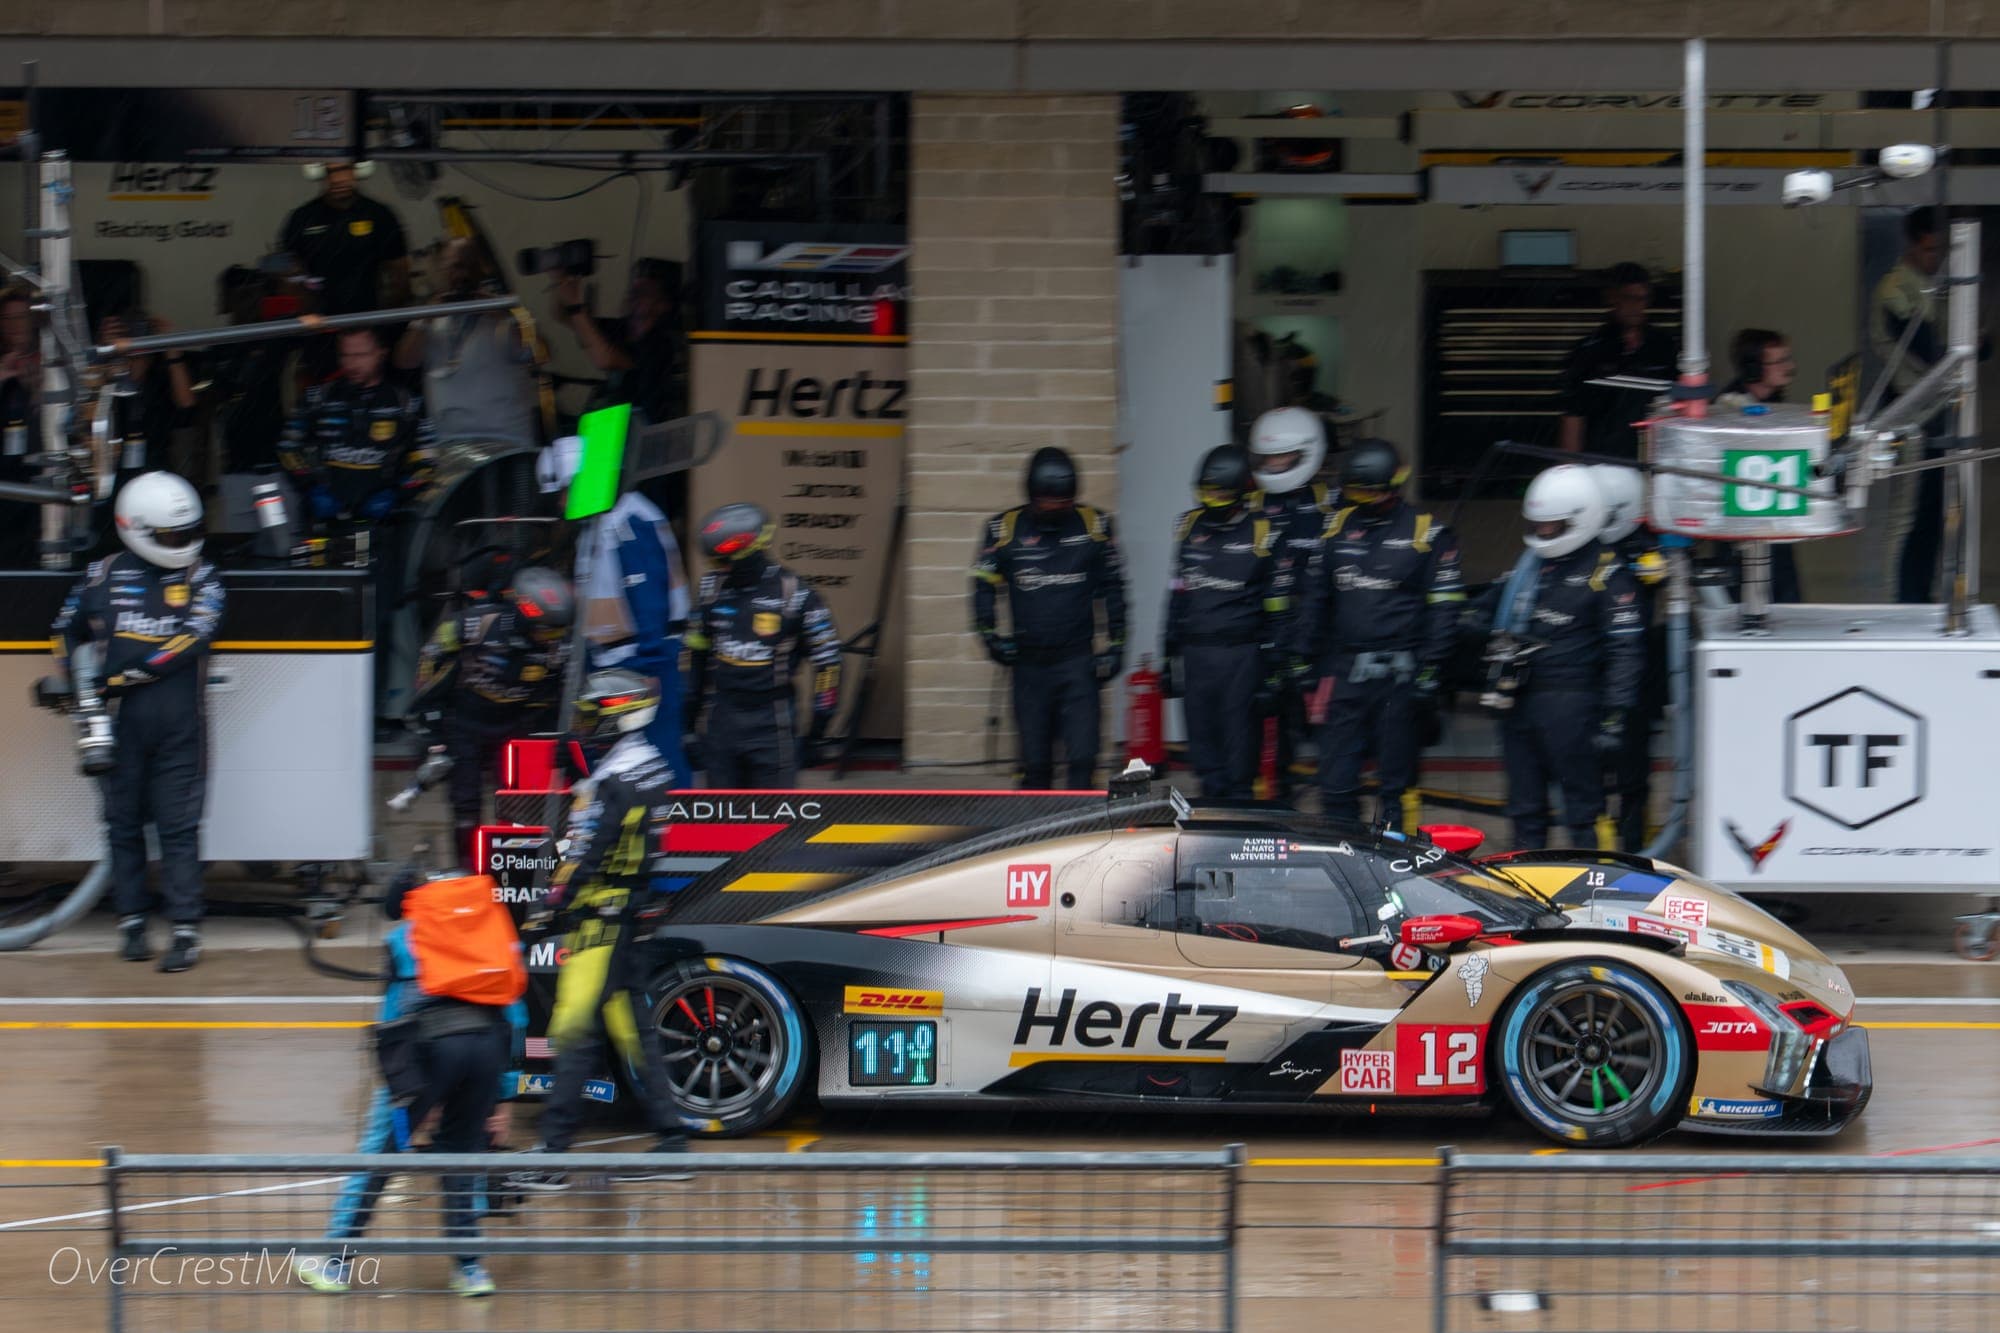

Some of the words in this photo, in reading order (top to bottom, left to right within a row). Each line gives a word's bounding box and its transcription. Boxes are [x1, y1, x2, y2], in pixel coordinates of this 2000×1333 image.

[725, 302, 880, 323] RACING
[737, 367, 908, 419] Hertz
[1735, 455, 1799, 512] 81
[1806, 734, 1909, 788] TF
[667, 801, 822, 820] ADILLAC
[1230, 853, 1275, 861] W.STEVENS
[1242, 845, 1275, 853] N.NATO
[506, 854, 557, 870] Palantir
[1009, 872, 1047, 901] HY
[1586, 872, 1606, 886] 12
[858, 993, 929, 1010] DHL
[1014, 986, 1239, 1051] Hertz
[1700, 1022, 1758, 1034] JOTA
[1344, 1053, 1390, 1067] HYPER
[1416, 1031, 1478, 1087] 12
[1344, 1067, 1392, 1089] CAR
[1719, 1104, 1777, 1113] MICHELIN
